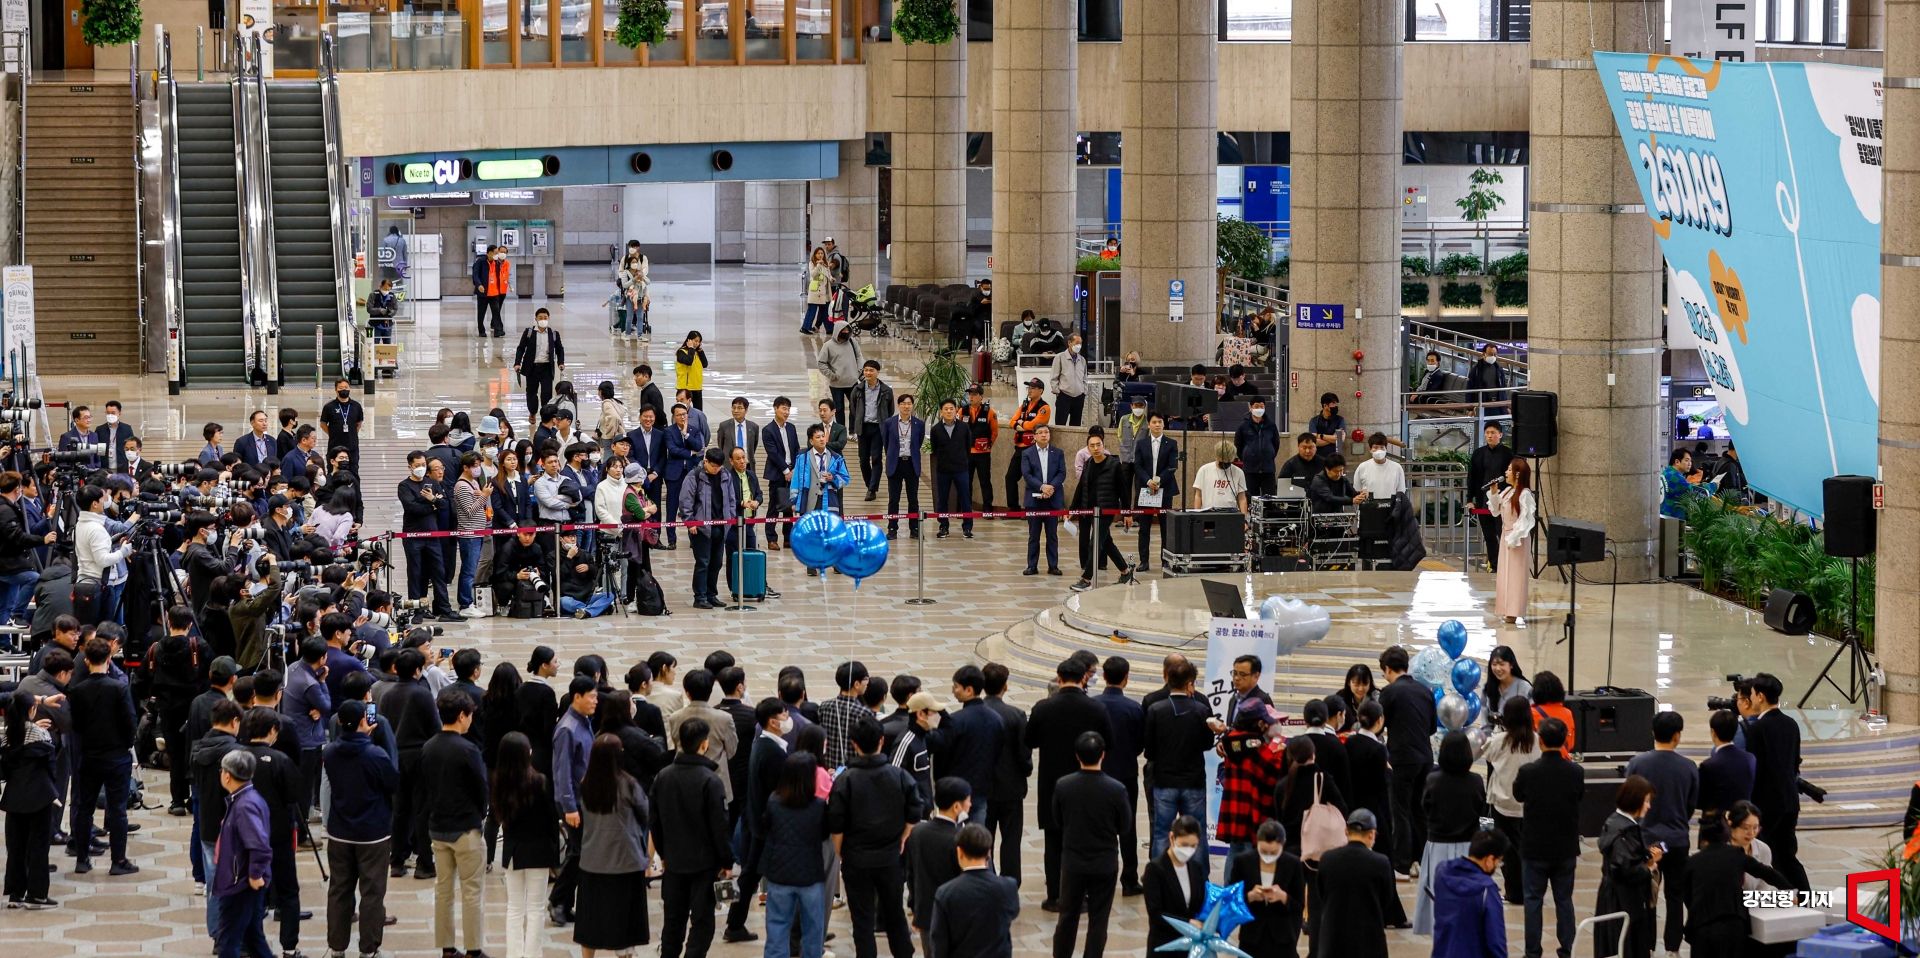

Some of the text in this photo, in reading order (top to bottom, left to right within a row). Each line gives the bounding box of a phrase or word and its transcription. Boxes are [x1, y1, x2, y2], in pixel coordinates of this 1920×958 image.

[410, 159, 460, 185] Nice to CU
[1639, 141, 1732, 237] 26DAY
[1213, 480, 1230, 488] 1987
